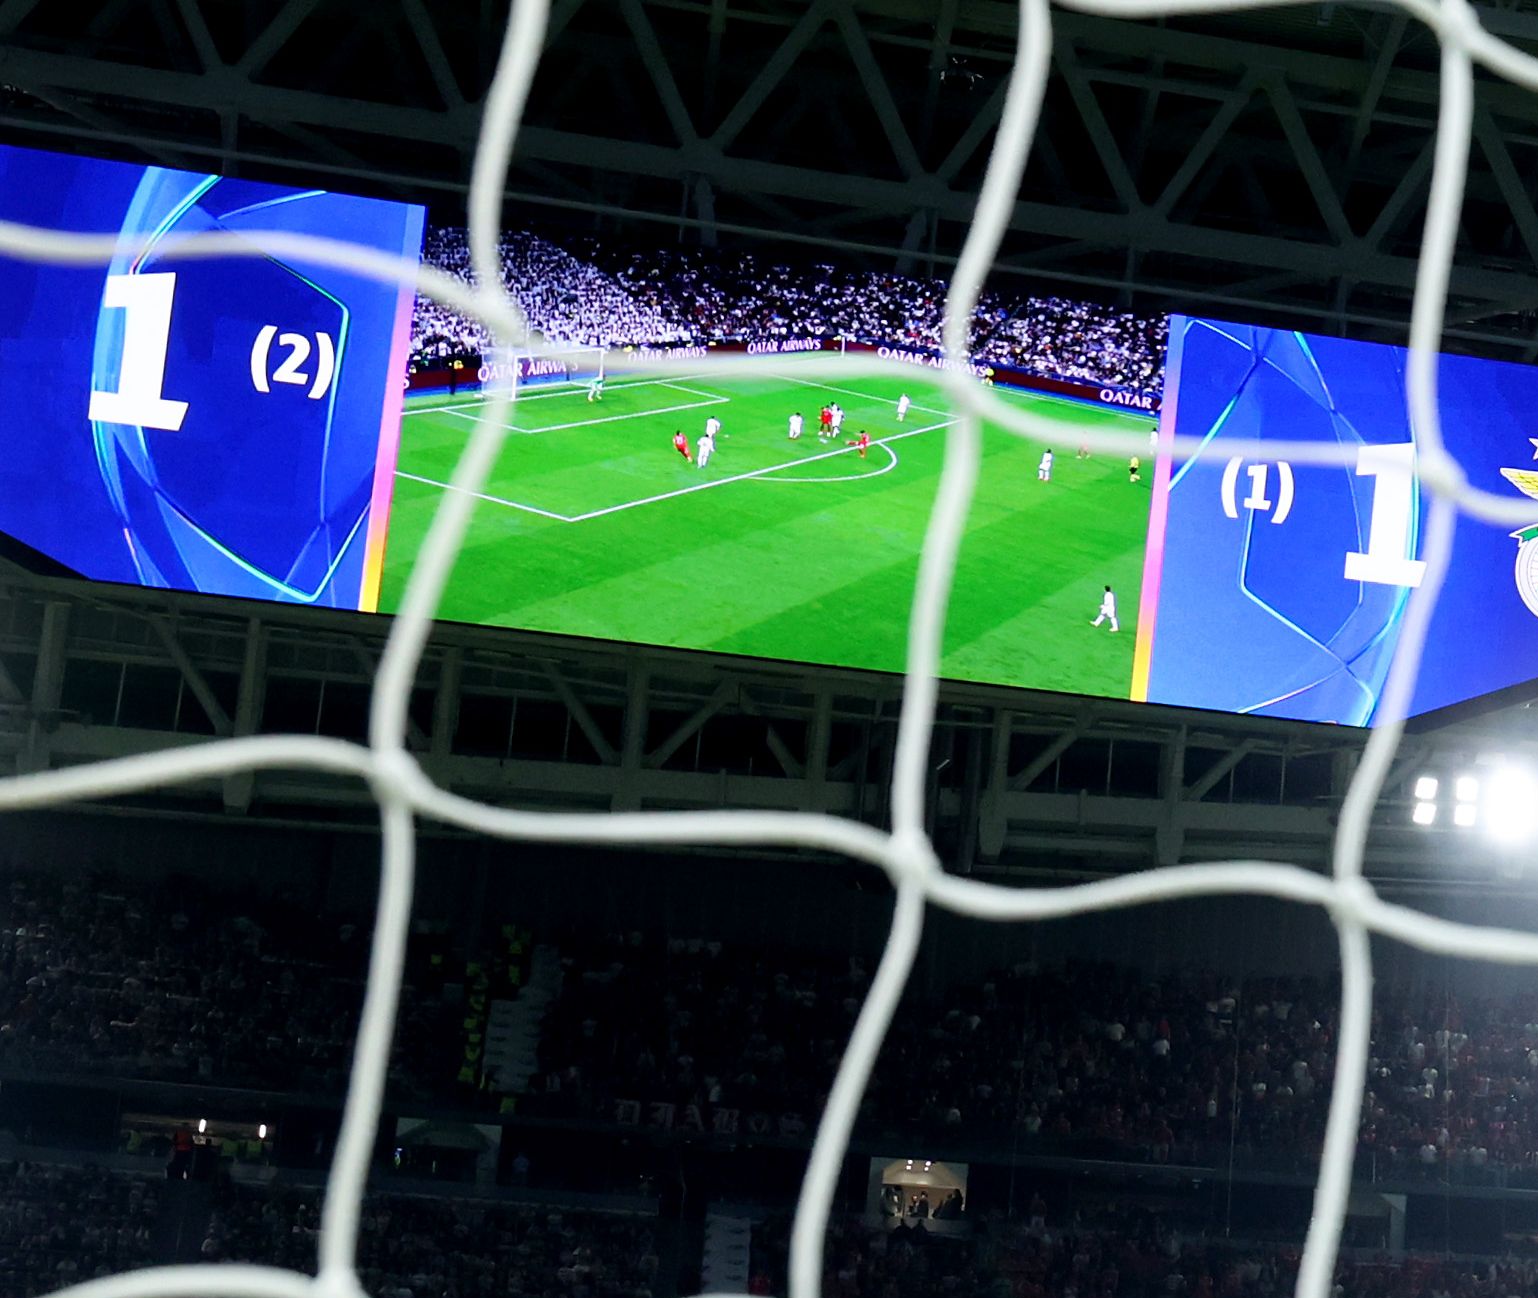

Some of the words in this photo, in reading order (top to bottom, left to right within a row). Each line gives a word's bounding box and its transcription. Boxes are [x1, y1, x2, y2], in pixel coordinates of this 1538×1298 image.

[88, 272, 189, 431] 1
[250, 325, 334, 400] (2)
[748, 341, 779, 354] QATAR
[780, 338, 821, 351] AIRWAYS
[877, 346, 924, 364] QATAR
[1099, 389, 1153, 411] QATAR
[1221, 456, 1294, 524] (1)
[1344, 442, 1428, 588] 1
